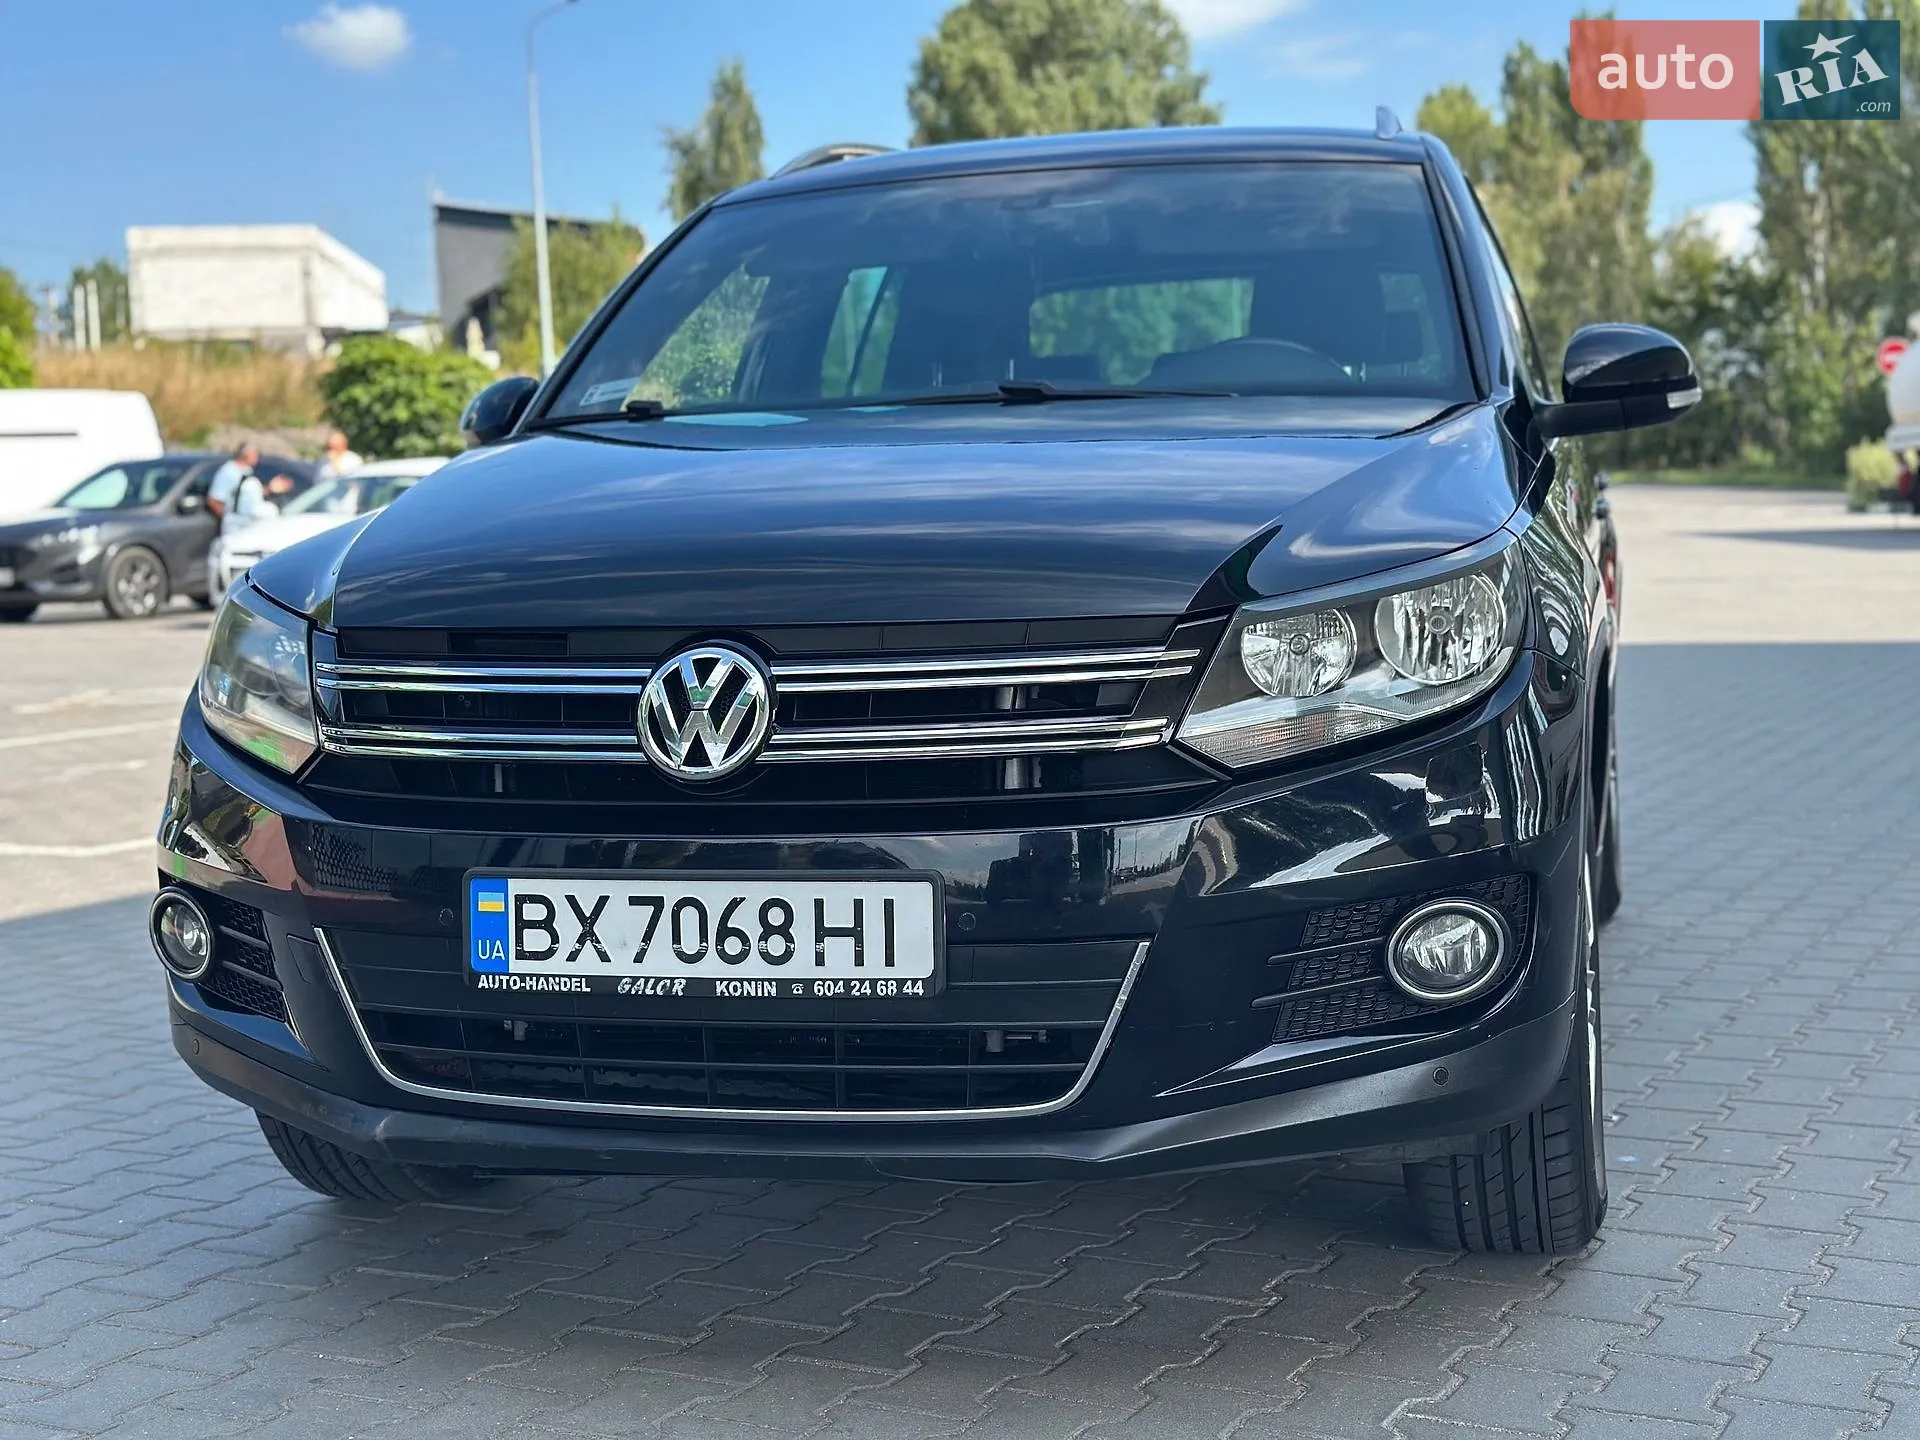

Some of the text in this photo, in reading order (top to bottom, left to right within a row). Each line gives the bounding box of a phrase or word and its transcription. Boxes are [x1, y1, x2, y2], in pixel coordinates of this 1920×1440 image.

[514, 894, 895, 967] BX 7068 HI
[478, 940, 505, 961] UA
[478, 975, 591, 993] AUTO-HANDEL
[814, 980, 845, 996] 604
[851, 981, 871, 996] 24
[877, 980, 897, 996] 68
[903, 980, 925, 996] 44
